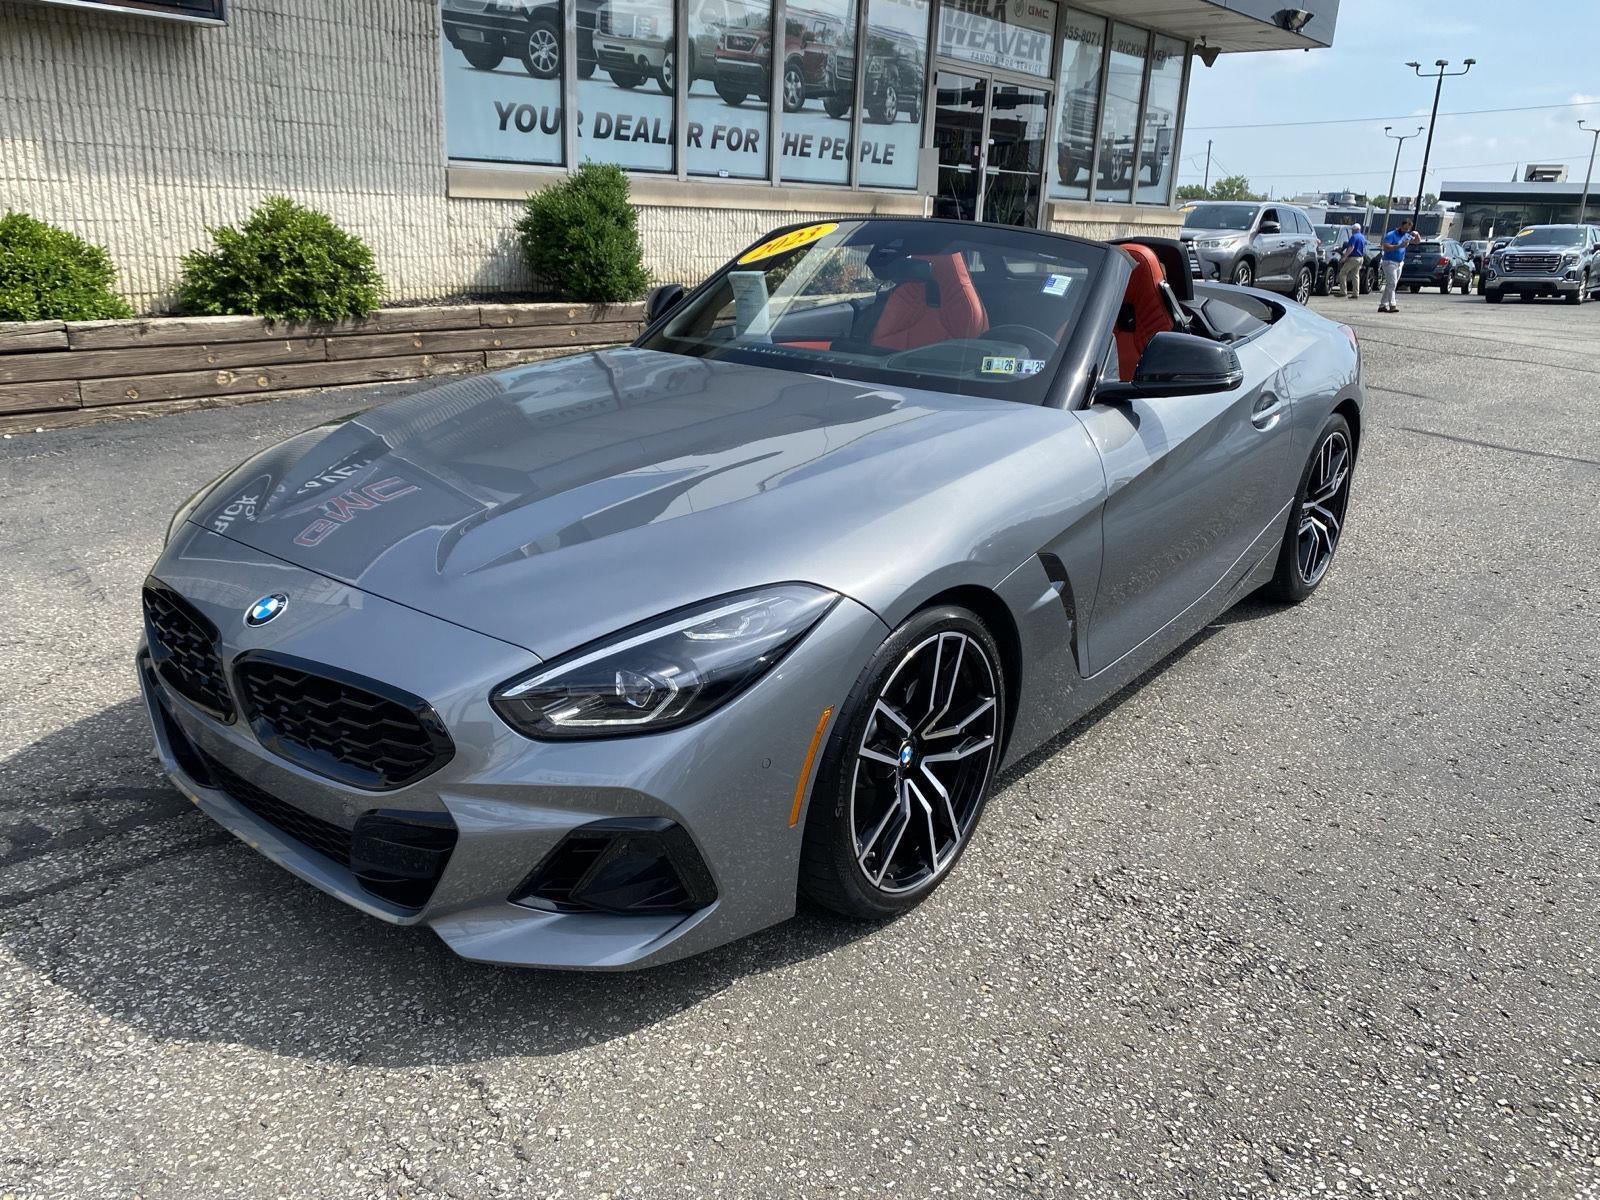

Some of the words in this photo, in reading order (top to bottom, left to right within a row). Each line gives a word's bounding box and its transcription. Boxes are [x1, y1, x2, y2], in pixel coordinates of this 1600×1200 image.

[1028, 5, 1050, 19] GMC
[942, 14, 1047, 61] WEAVER
[593, 111, 703, 149] DEALR
[711, 125, 760, 153] FOR
[781, 131, 814, 158] HE
[818, 137, 895, 165] PEPLE
[748, 225, 822, 260] 2023
[986, 360, 993, 371] 9
